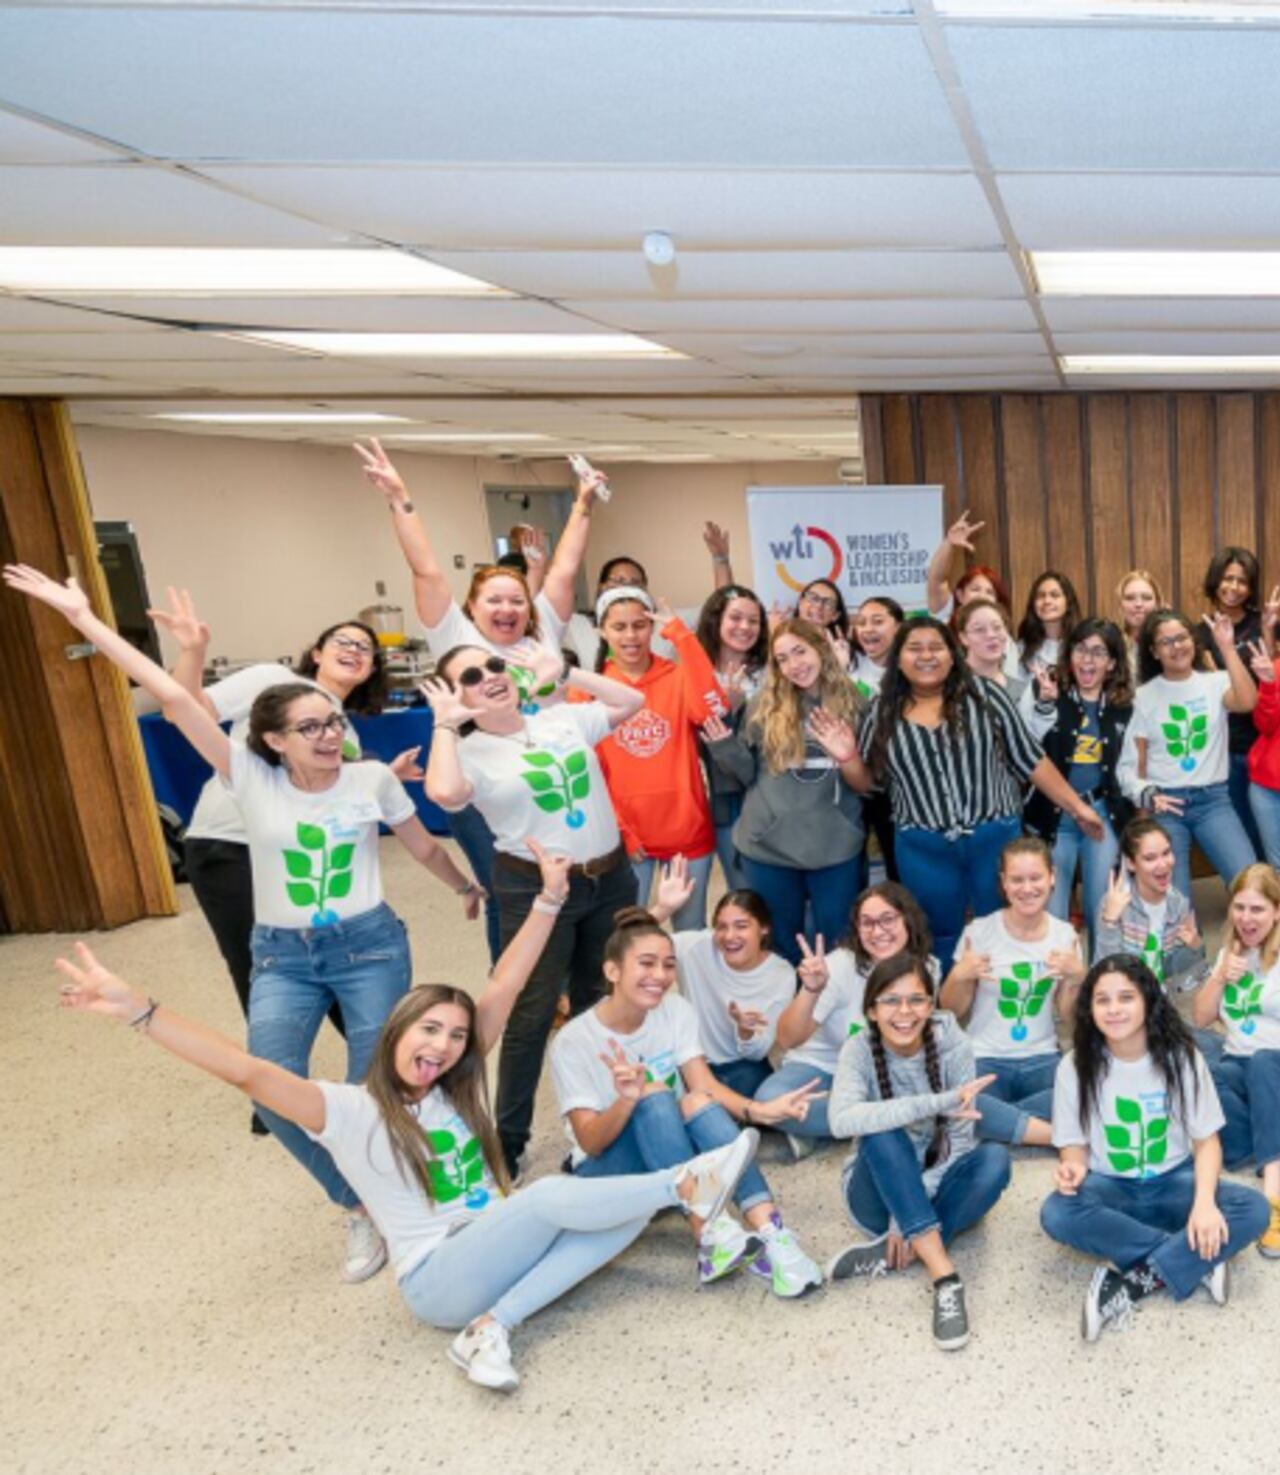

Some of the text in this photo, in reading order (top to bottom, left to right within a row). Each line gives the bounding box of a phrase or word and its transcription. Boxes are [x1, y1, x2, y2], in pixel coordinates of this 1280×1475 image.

[846, 531, 910, 551] WOMEN'S
[846, 549, 929, 570] LEADERSHIP
[849, 571, 858, 587] &
